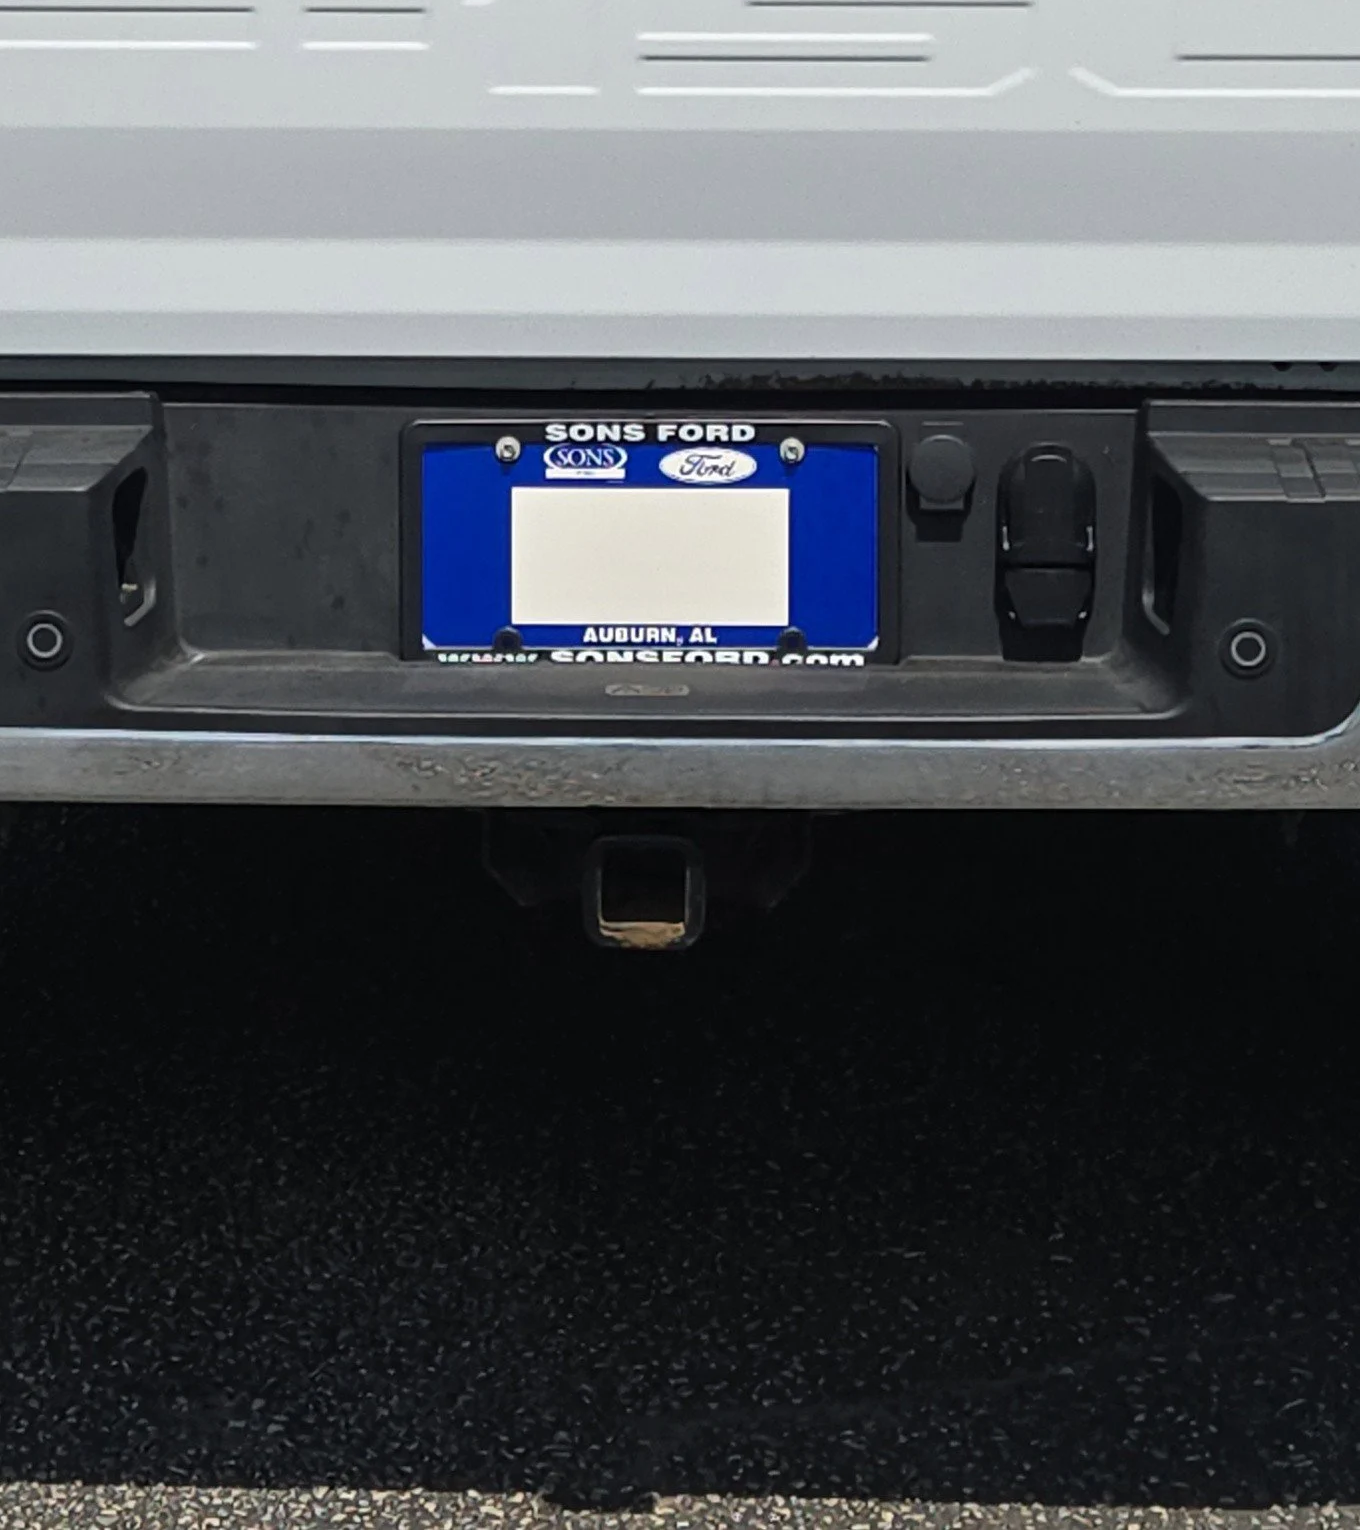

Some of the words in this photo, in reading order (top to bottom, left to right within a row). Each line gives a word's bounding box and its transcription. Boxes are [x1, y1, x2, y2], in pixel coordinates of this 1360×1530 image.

[545, 423, 645, 442] SONS
[657, 424, 755, 442] FORD
[555, 445, 616, 467] SONS
[679, 453, 737, 478] Ford
[582, 626, 684, 647] AUBURN,
[688, 627, 718, 644] AL
